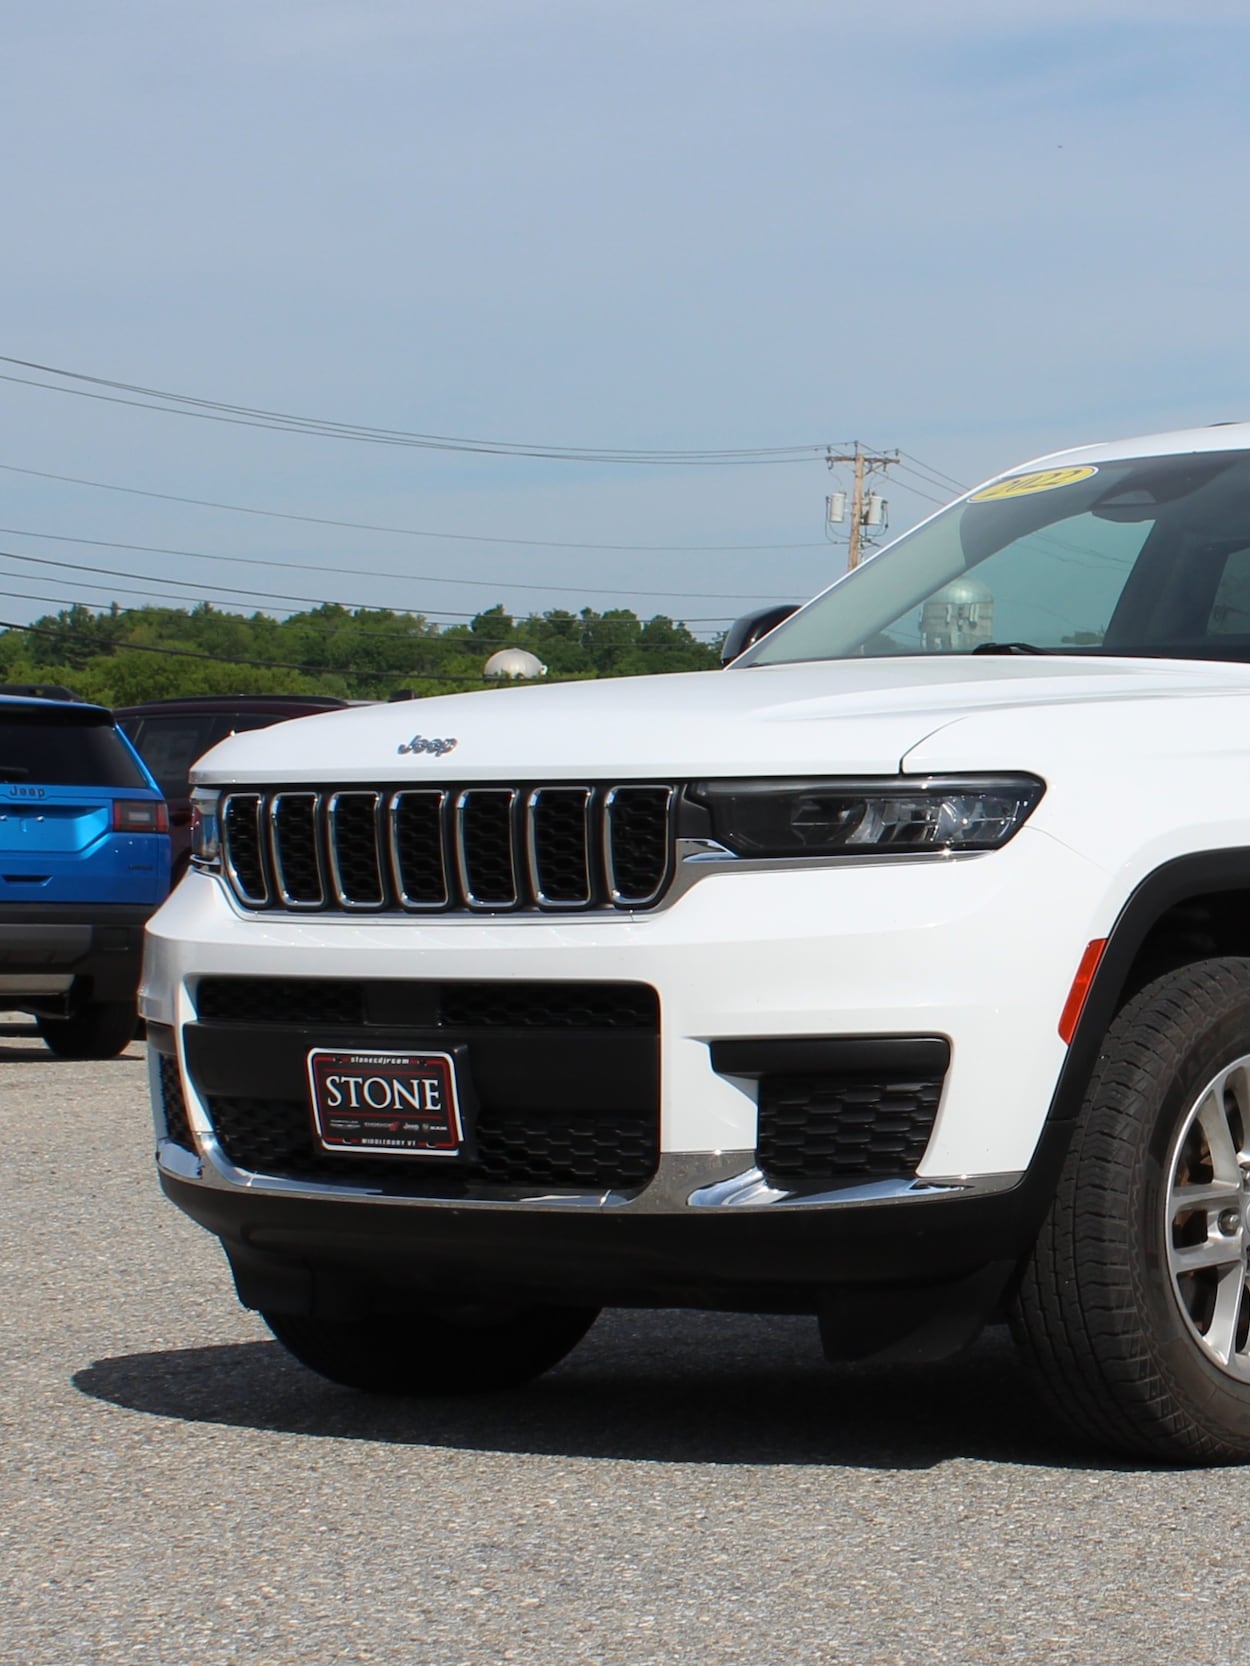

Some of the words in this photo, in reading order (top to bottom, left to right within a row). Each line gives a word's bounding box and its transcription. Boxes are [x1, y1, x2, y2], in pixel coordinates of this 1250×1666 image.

[397, 734, 459, 757] Jeep
[10, 784, 46, 800] Jeep
[325, 1075, 442, 1111] STONE
